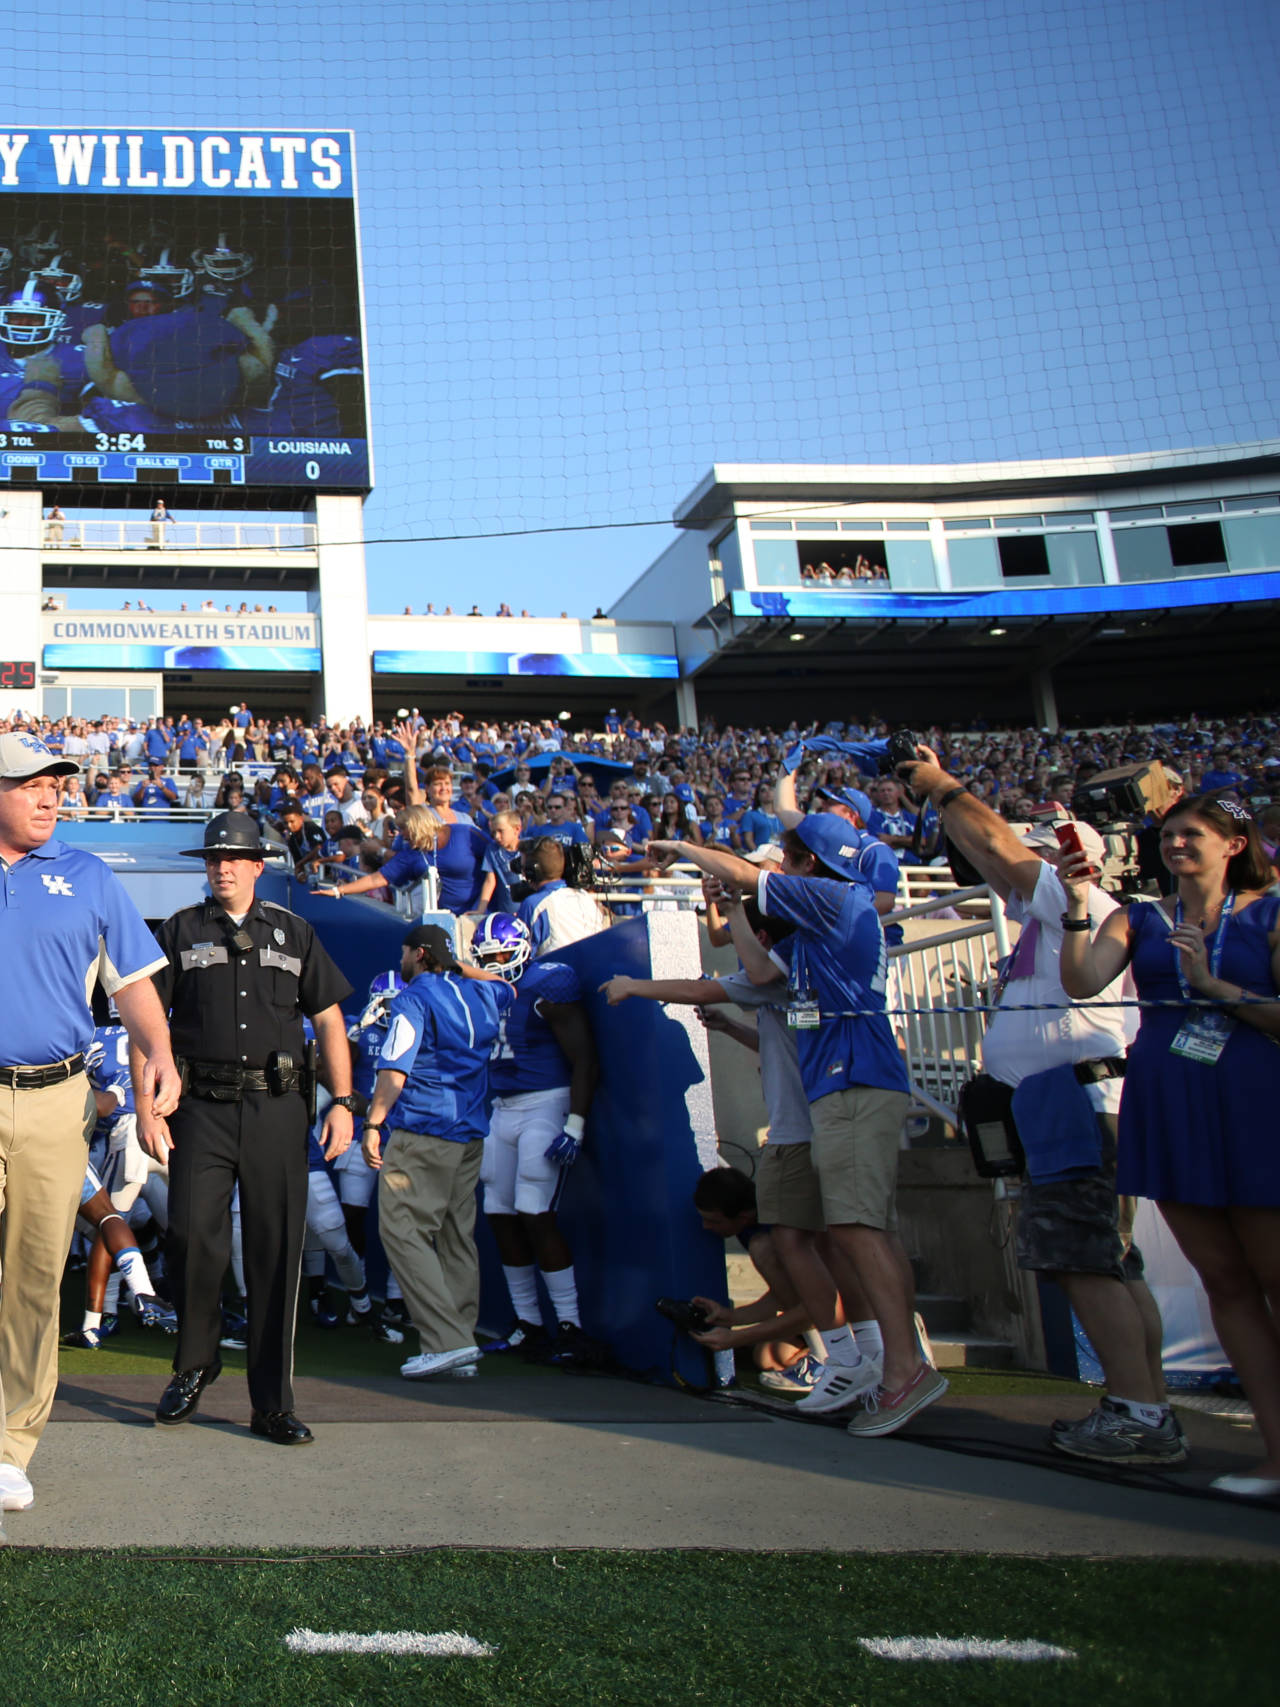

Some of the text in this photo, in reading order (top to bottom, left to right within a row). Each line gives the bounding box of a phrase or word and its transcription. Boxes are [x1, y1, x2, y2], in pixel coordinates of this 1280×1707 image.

[49, 135, 342, 190] WILDCATS
[11, 437, 35, 447] TOL
[95, 433, 146, 451] 3:54
[206, 438, 244, 451] TOL 3
[269, 441, 352, 455] LOUISIANA
[6, 456, 40, 465] DOWN
[70, 456, 83, 465] TO
[136, 457, 161, 467] BALL
[210, 458, 233, 468] QTR
[305, 460, 320, 480] 0
[53, 622, 311, 641] COMMONWEALTH STADIUM
[0, 662, 35, 685] 25
[41, 873, 74, 897] UK
